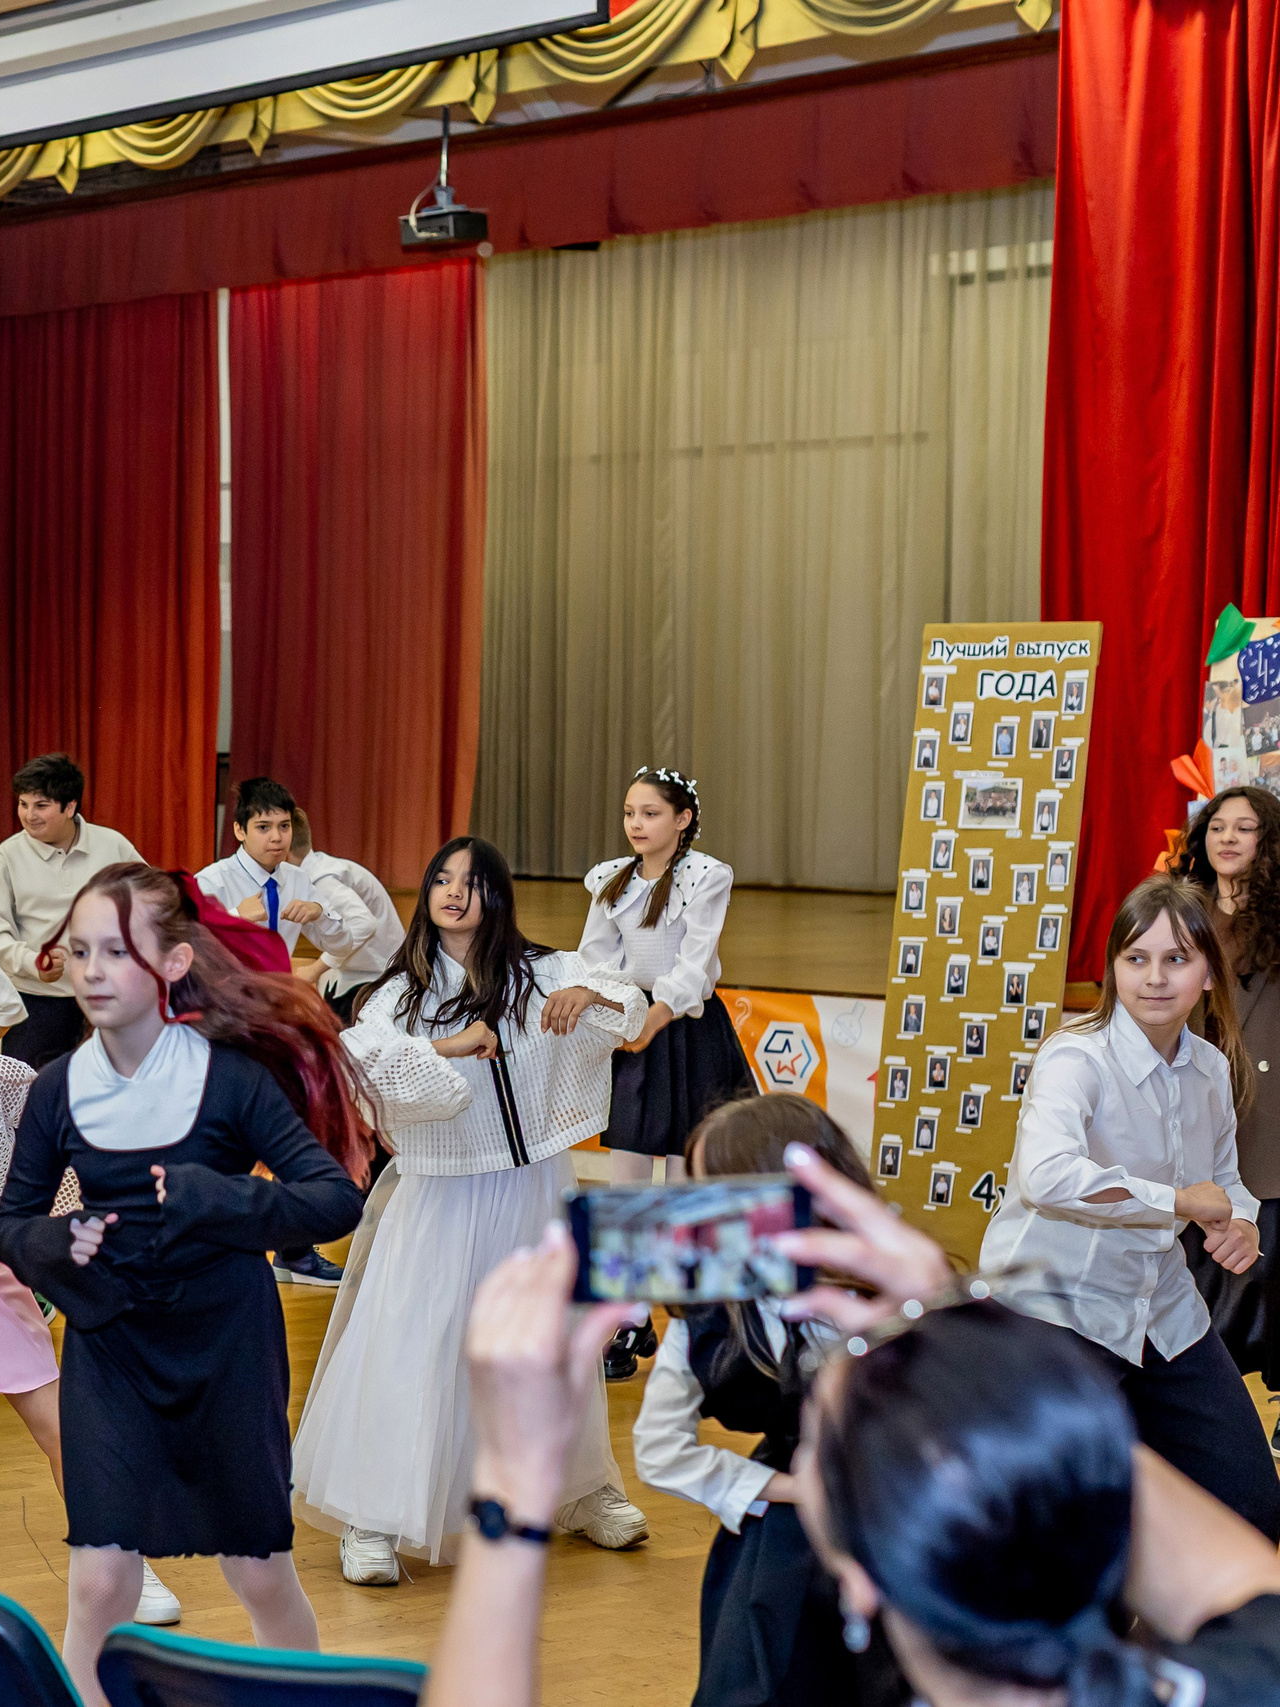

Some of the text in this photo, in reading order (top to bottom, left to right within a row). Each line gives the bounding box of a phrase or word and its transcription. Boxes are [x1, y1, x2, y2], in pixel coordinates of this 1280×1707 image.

[930, 637, 1089, 663] Лучший выпуск
[979, 672, 1056, 701] ГОДА
